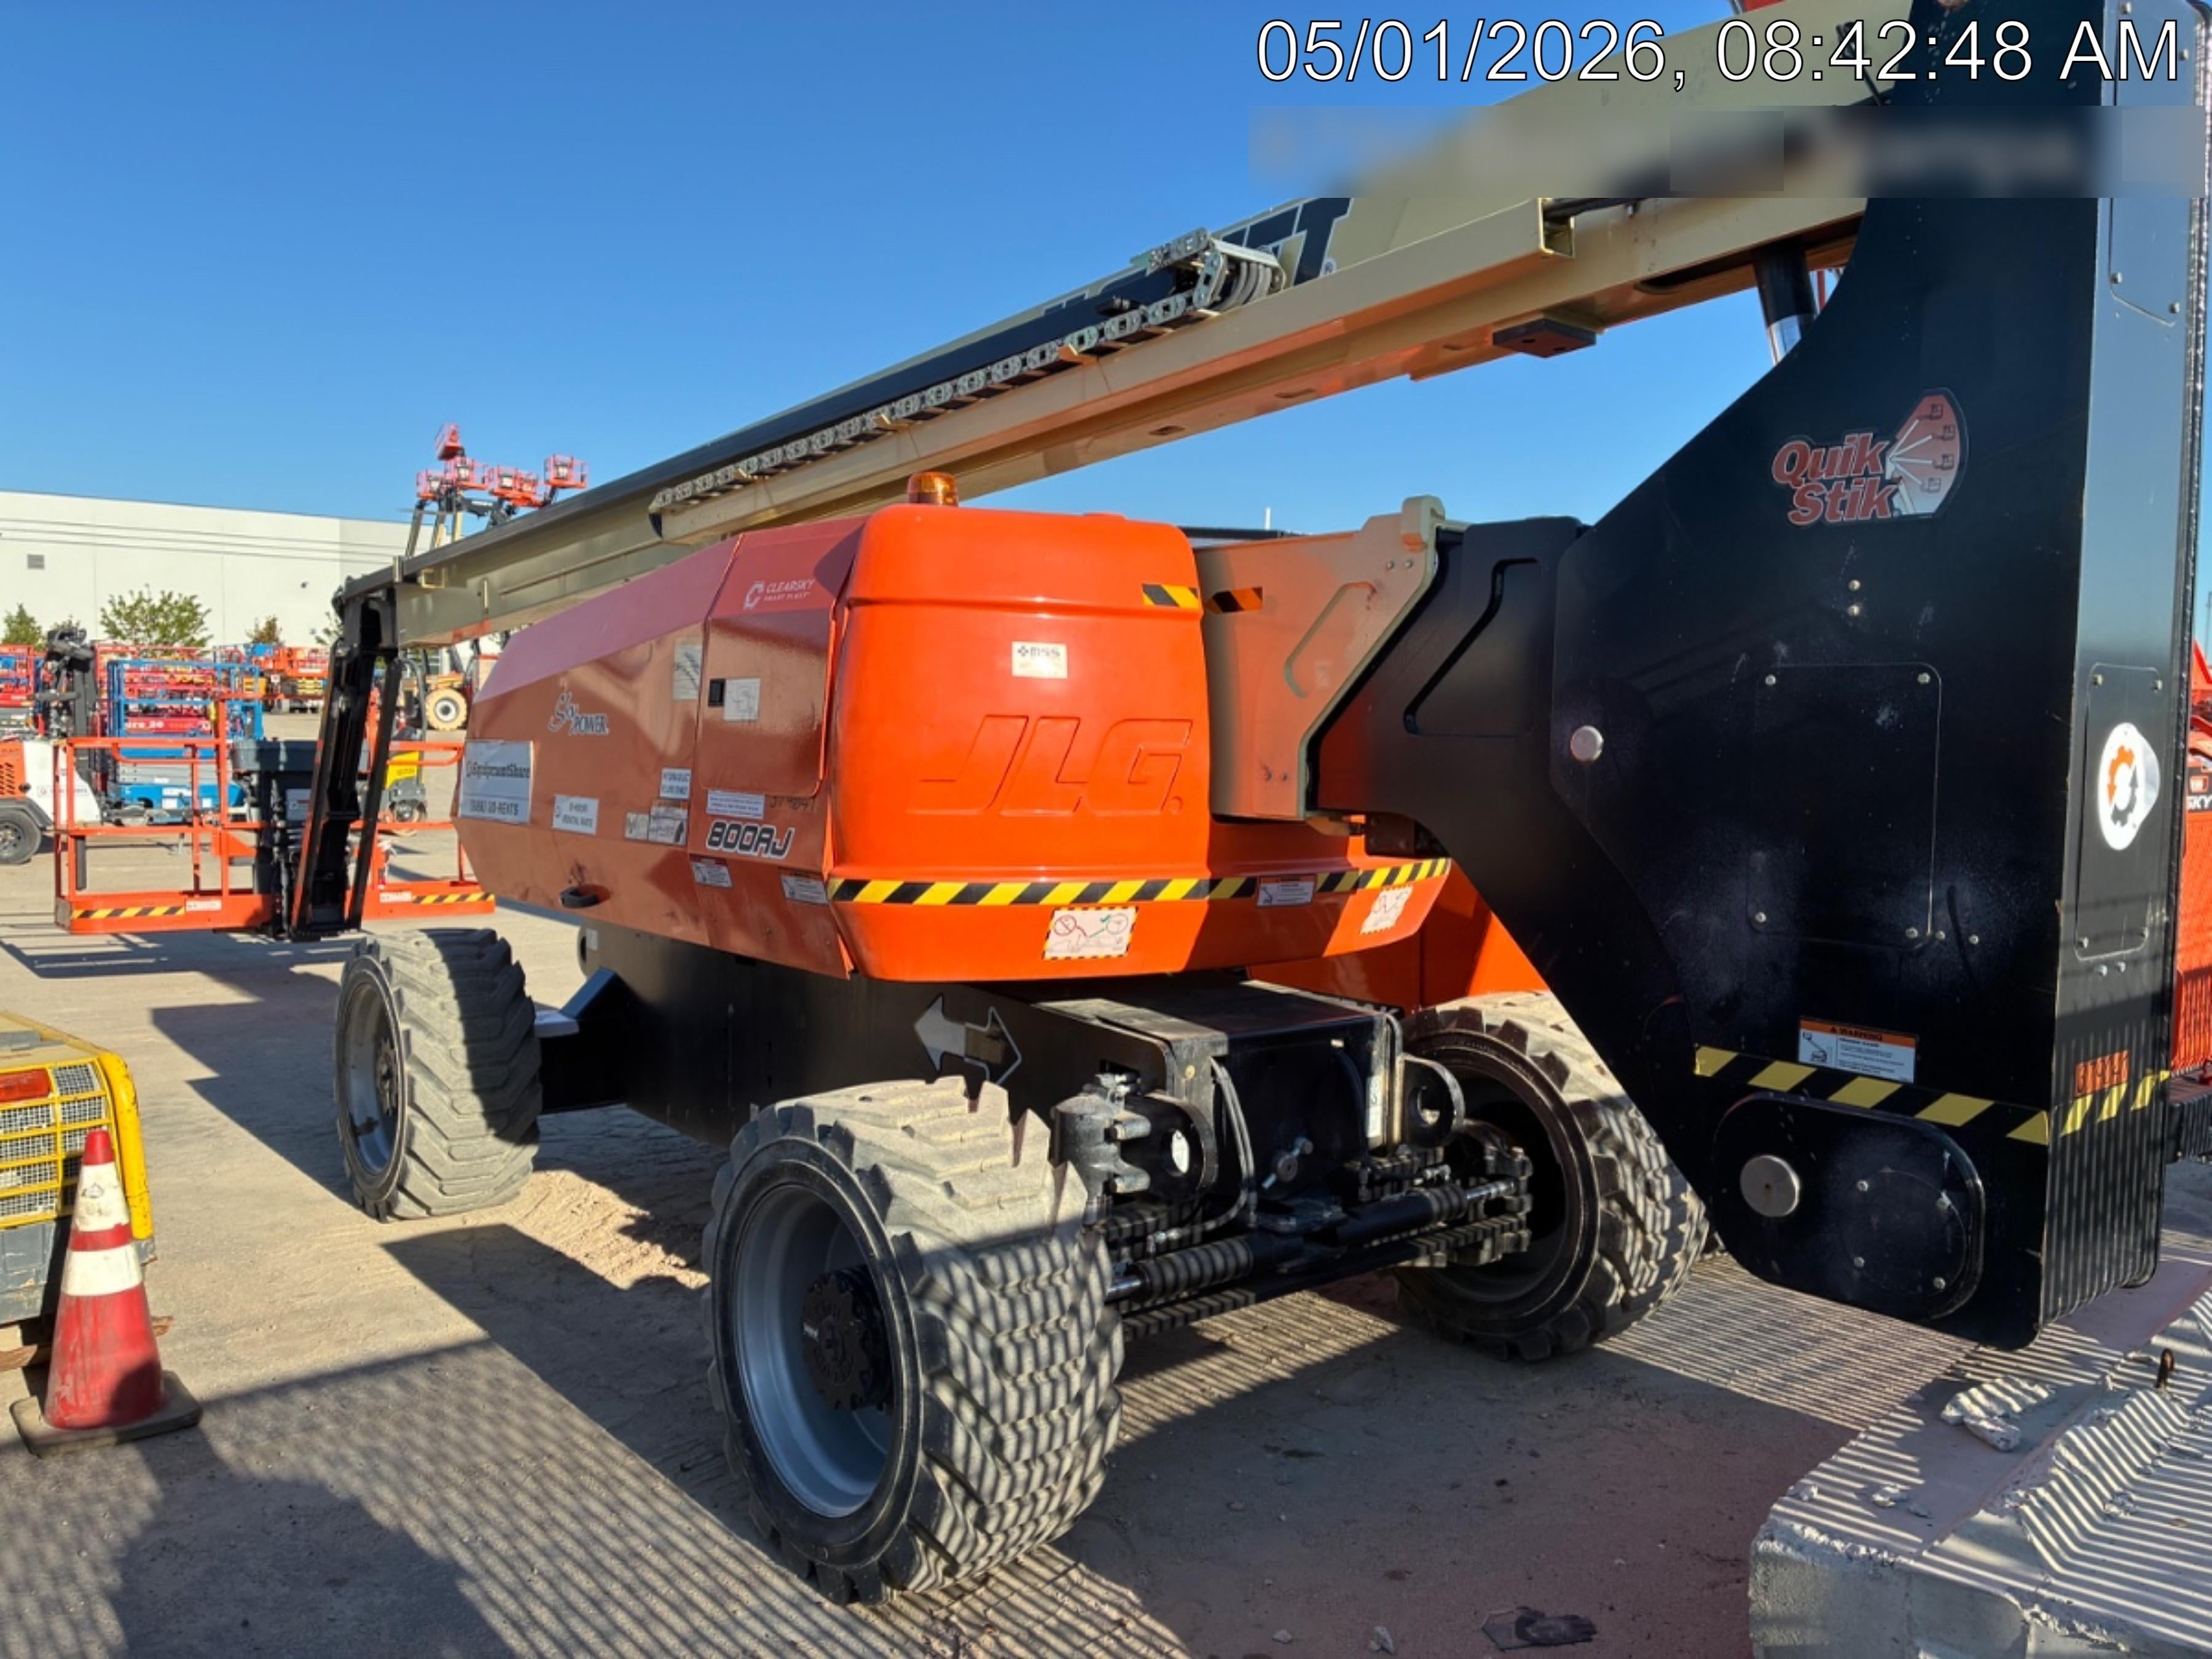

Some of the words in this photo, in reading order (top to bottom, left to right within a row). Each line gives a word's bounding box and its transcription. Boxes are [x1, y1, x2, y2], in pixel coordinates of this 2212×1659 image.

[1772, 433, 1889, 488] Quik
[1788, 477, 1898, 526] Stik
[706, 820, 795, 859] 800AJ
